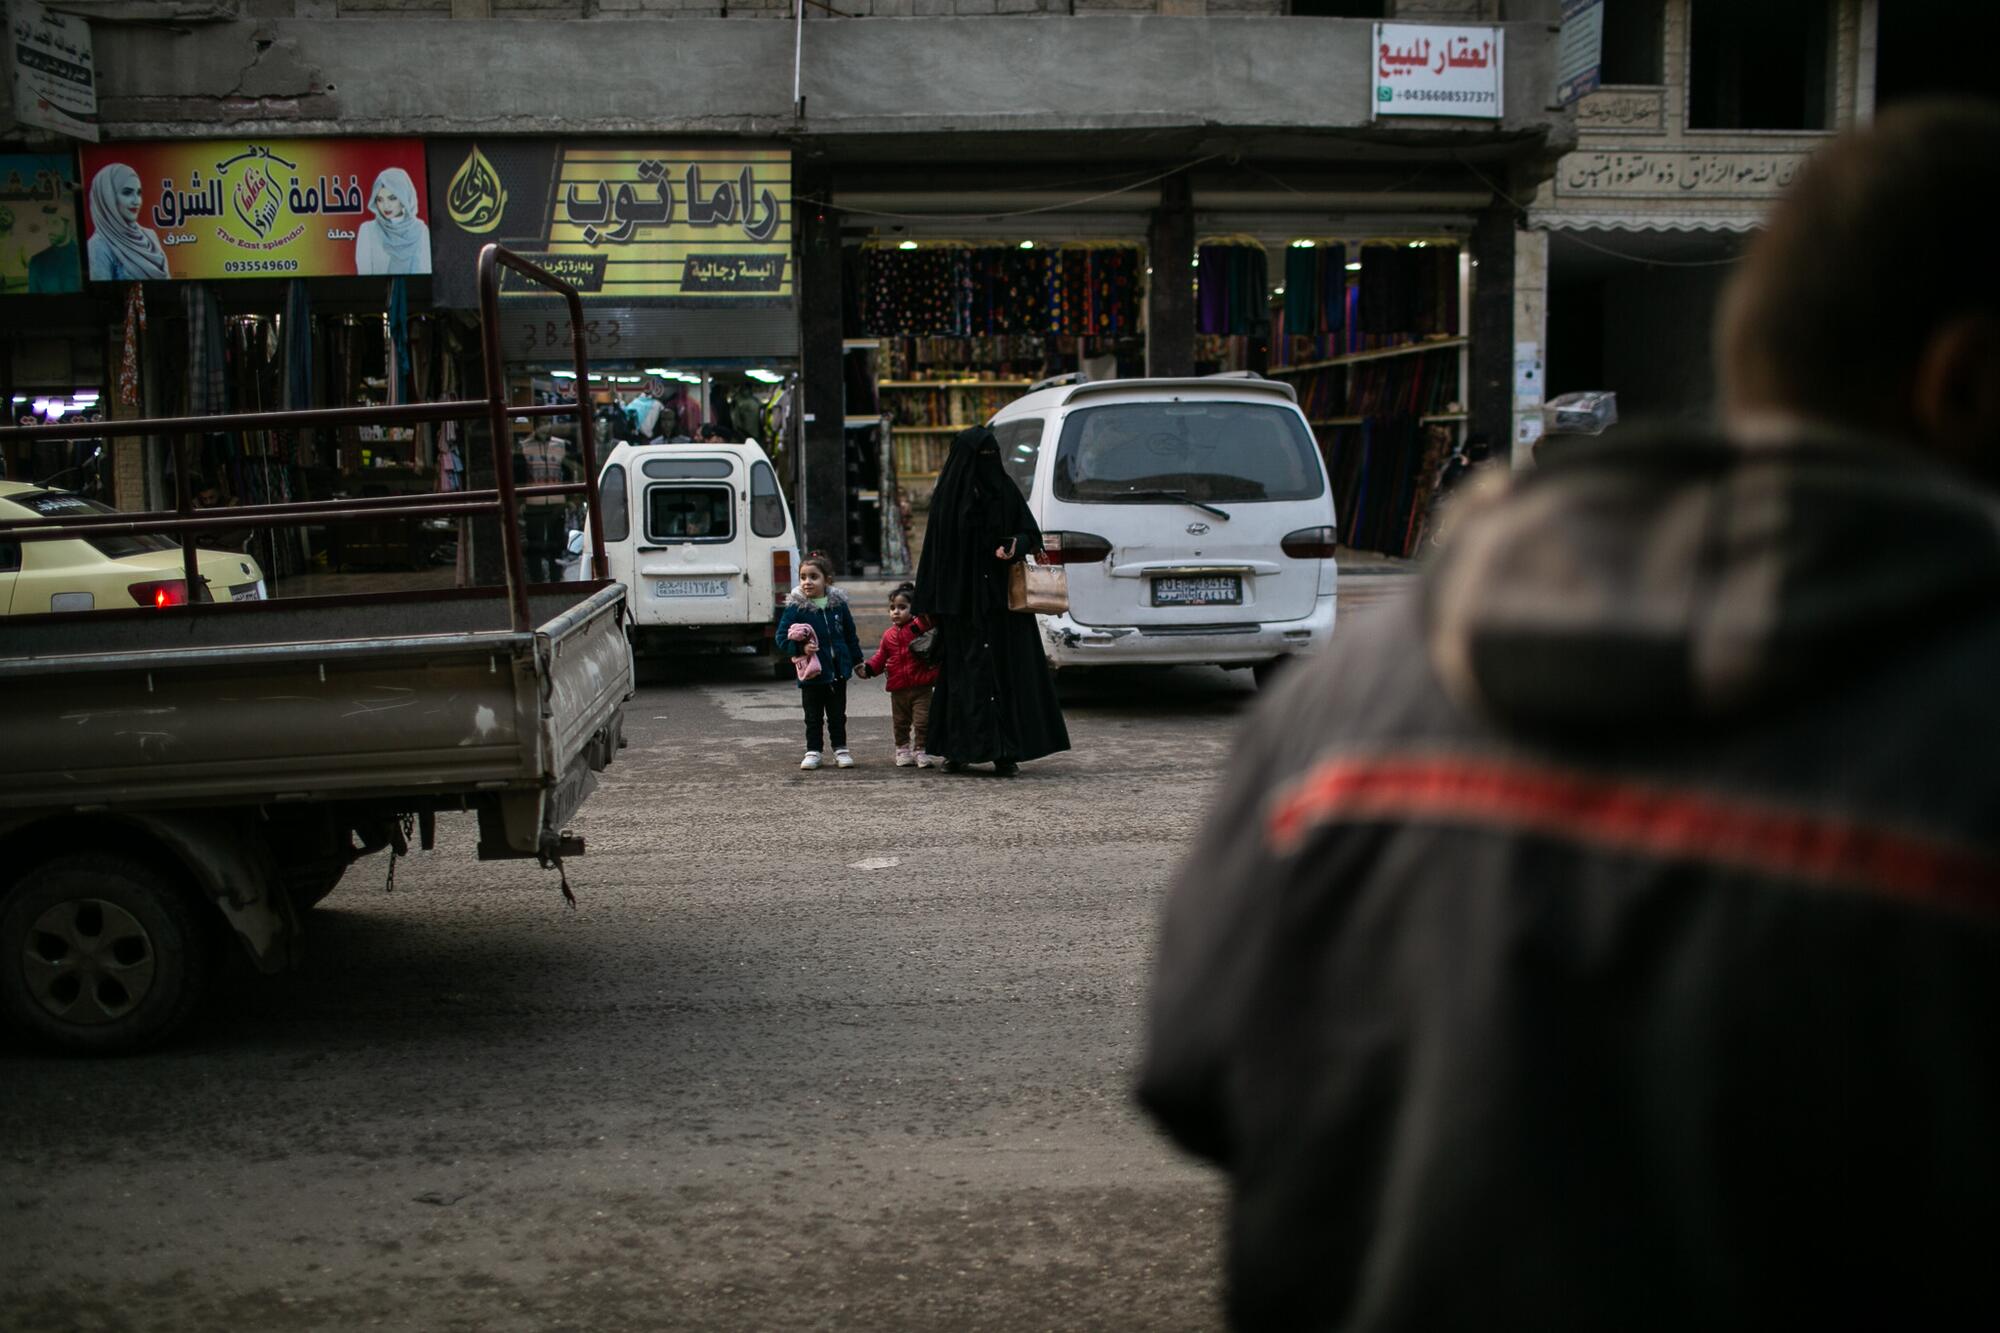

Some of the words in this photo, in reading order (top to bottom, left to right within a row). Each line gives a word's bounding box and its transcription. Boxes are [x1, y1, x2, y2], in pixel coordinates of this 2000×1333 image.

[1379, 37, 1430, 78] للبيع
[1433, 36, 1497, 75] العقار
[153, 170, 223, 227] الشرق
[289, 175, 362, 214] فخامة
[566, 159, 673, 244] توب
[684, 162, 779, 240] راما
[163, 231, 198, 246] مفرق
[216, 226, 236, 244] The
[242, 239, 266, 251] East
[263, 224, 306, 251] splendor
[327, 228, 356, 240] جملة
[224, 259, 299, 273] 0935549609
[690, 260, 736, 282] رجالية
